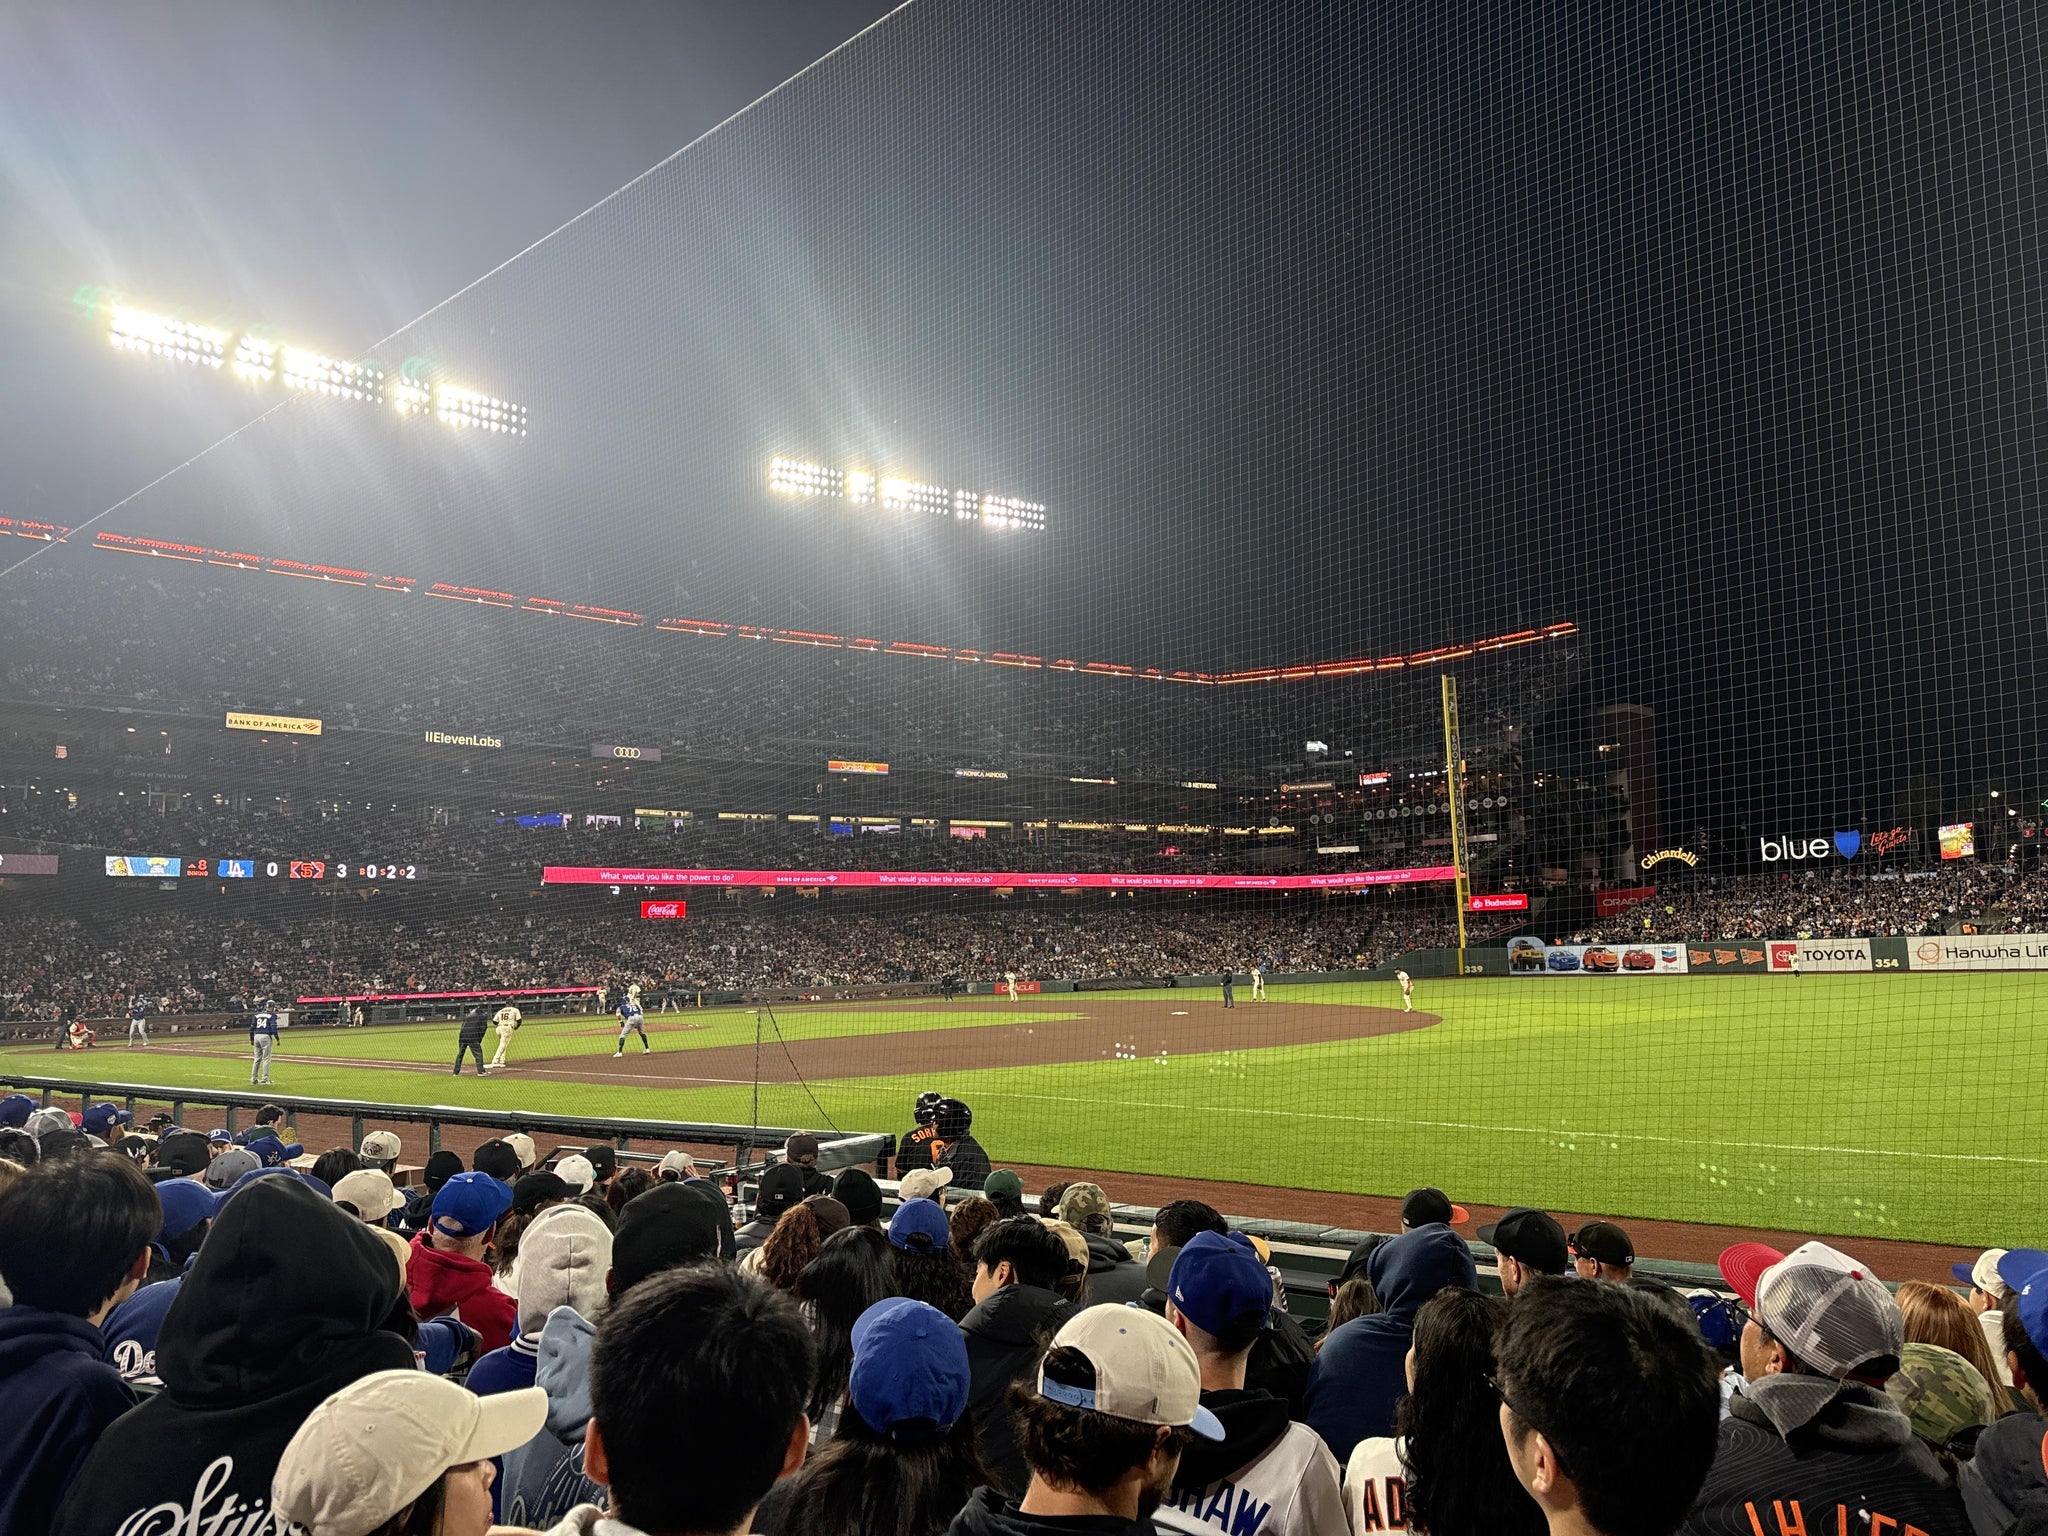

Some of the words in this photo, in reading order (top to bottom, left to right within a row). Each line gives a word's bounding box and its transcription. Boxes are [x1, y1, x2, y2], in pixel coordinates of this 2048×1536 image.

[265, 722, 302, 730] AMERICA
[1890, 826, 1904, 840] go
[1761, 835, 1829, 862] blue
[1641, 847, 1699, 869] Ghirardelli
[198, 859, 207, 870] 8
[266, 862, 278, 877] 0
[336, 864, 347, 878] 3
[600, 872, 620, 880] What
[622, 872, 644, 880] would
[661, 872, 674, 880] like
[676, 873, 688, 881] the
[880, 875, 896, 883] What
[931, 875, 941, 883] like
[1375, 874, 1392, 882] power
[1484, 898, 1523, 907] Budweiser
[1803, 949, 1867, 961] TOYOTA
[1946, 946, 2021, 959] Hanwha
[1875, 958, 1899, 968] 354
[1464, 965, 1484, 974] 339
[501, 1013, 510, 1021] 16
